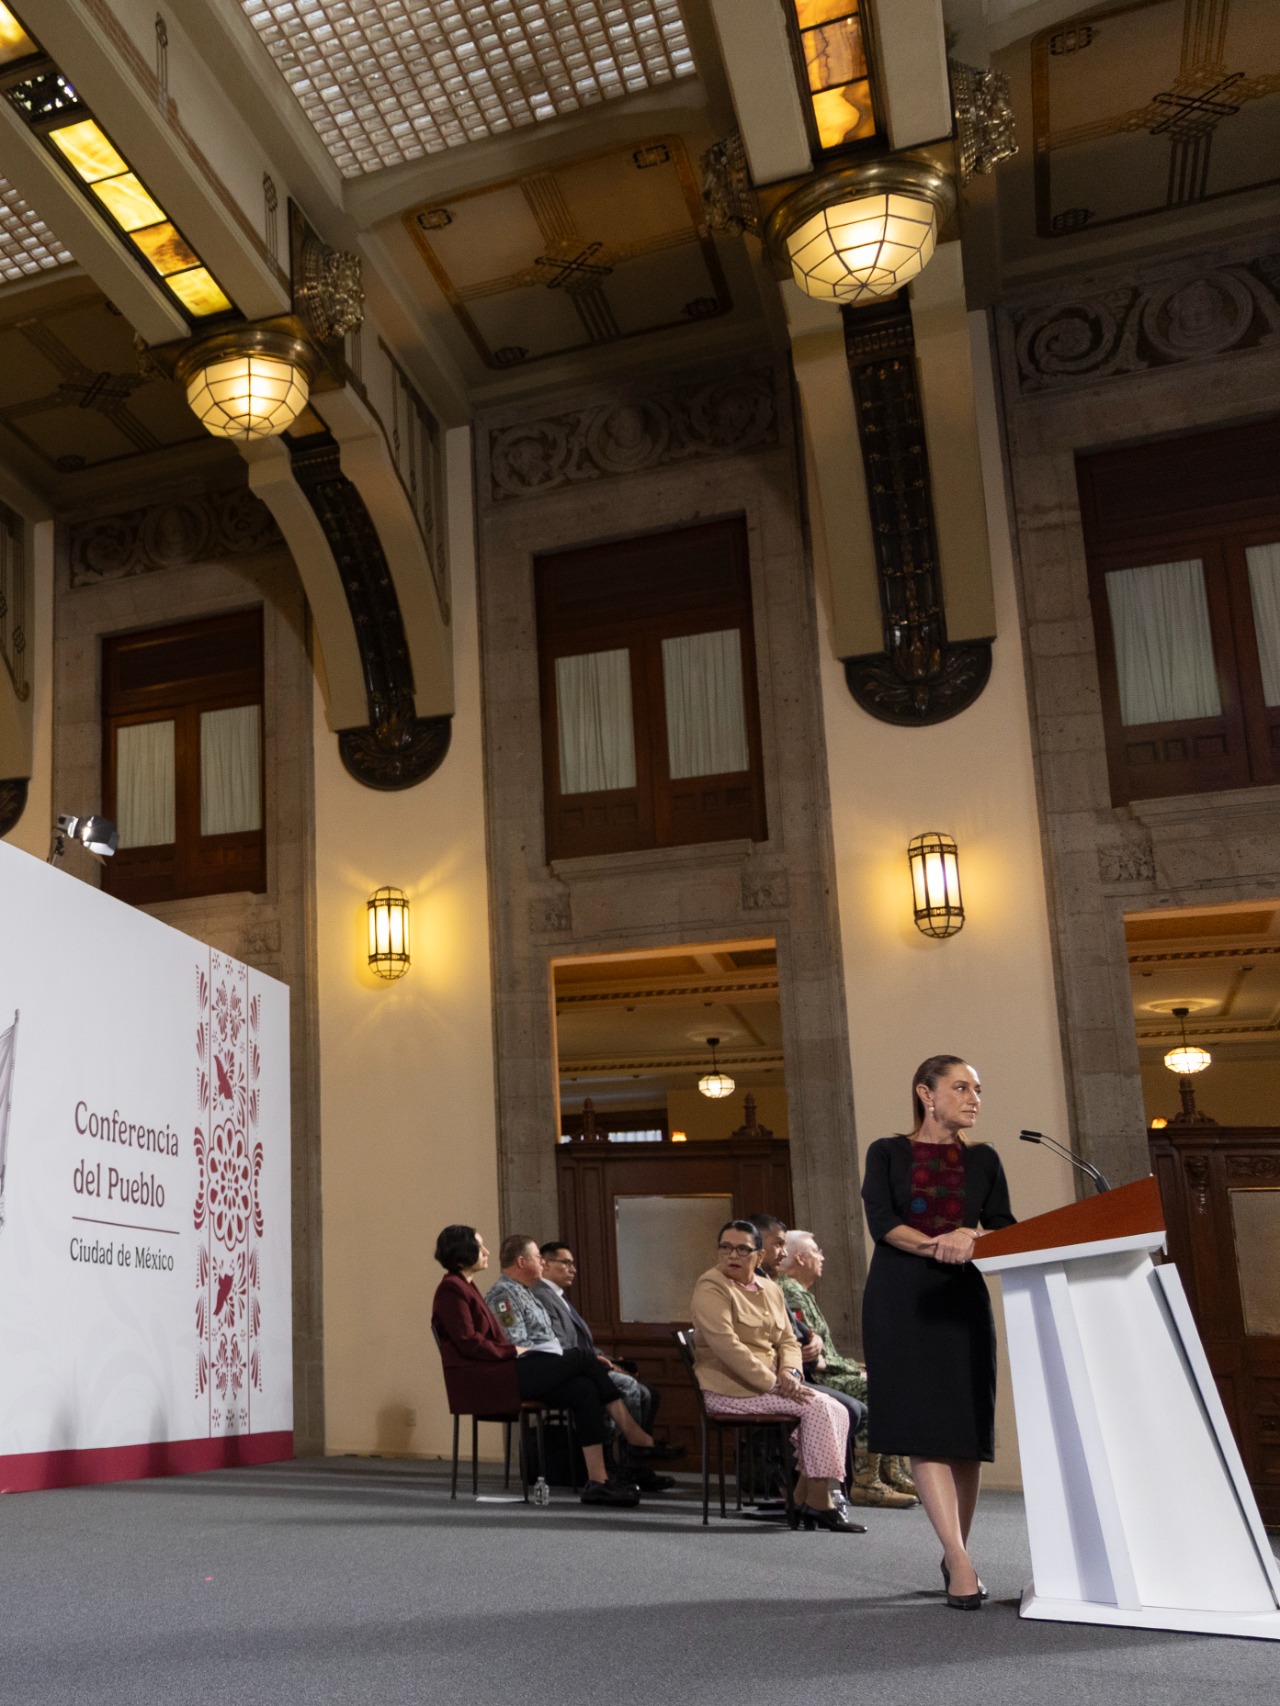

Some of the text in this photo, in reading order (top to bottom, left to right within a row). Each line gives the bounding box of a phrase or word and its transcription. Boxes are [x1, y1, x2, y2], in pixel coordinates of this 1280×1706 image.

[74, 1100, 179, 1157] Conferencia
[73, 1159, 165, 1208] del Pueblo
[70, 1237, 174, 1272] Ciudad de México
